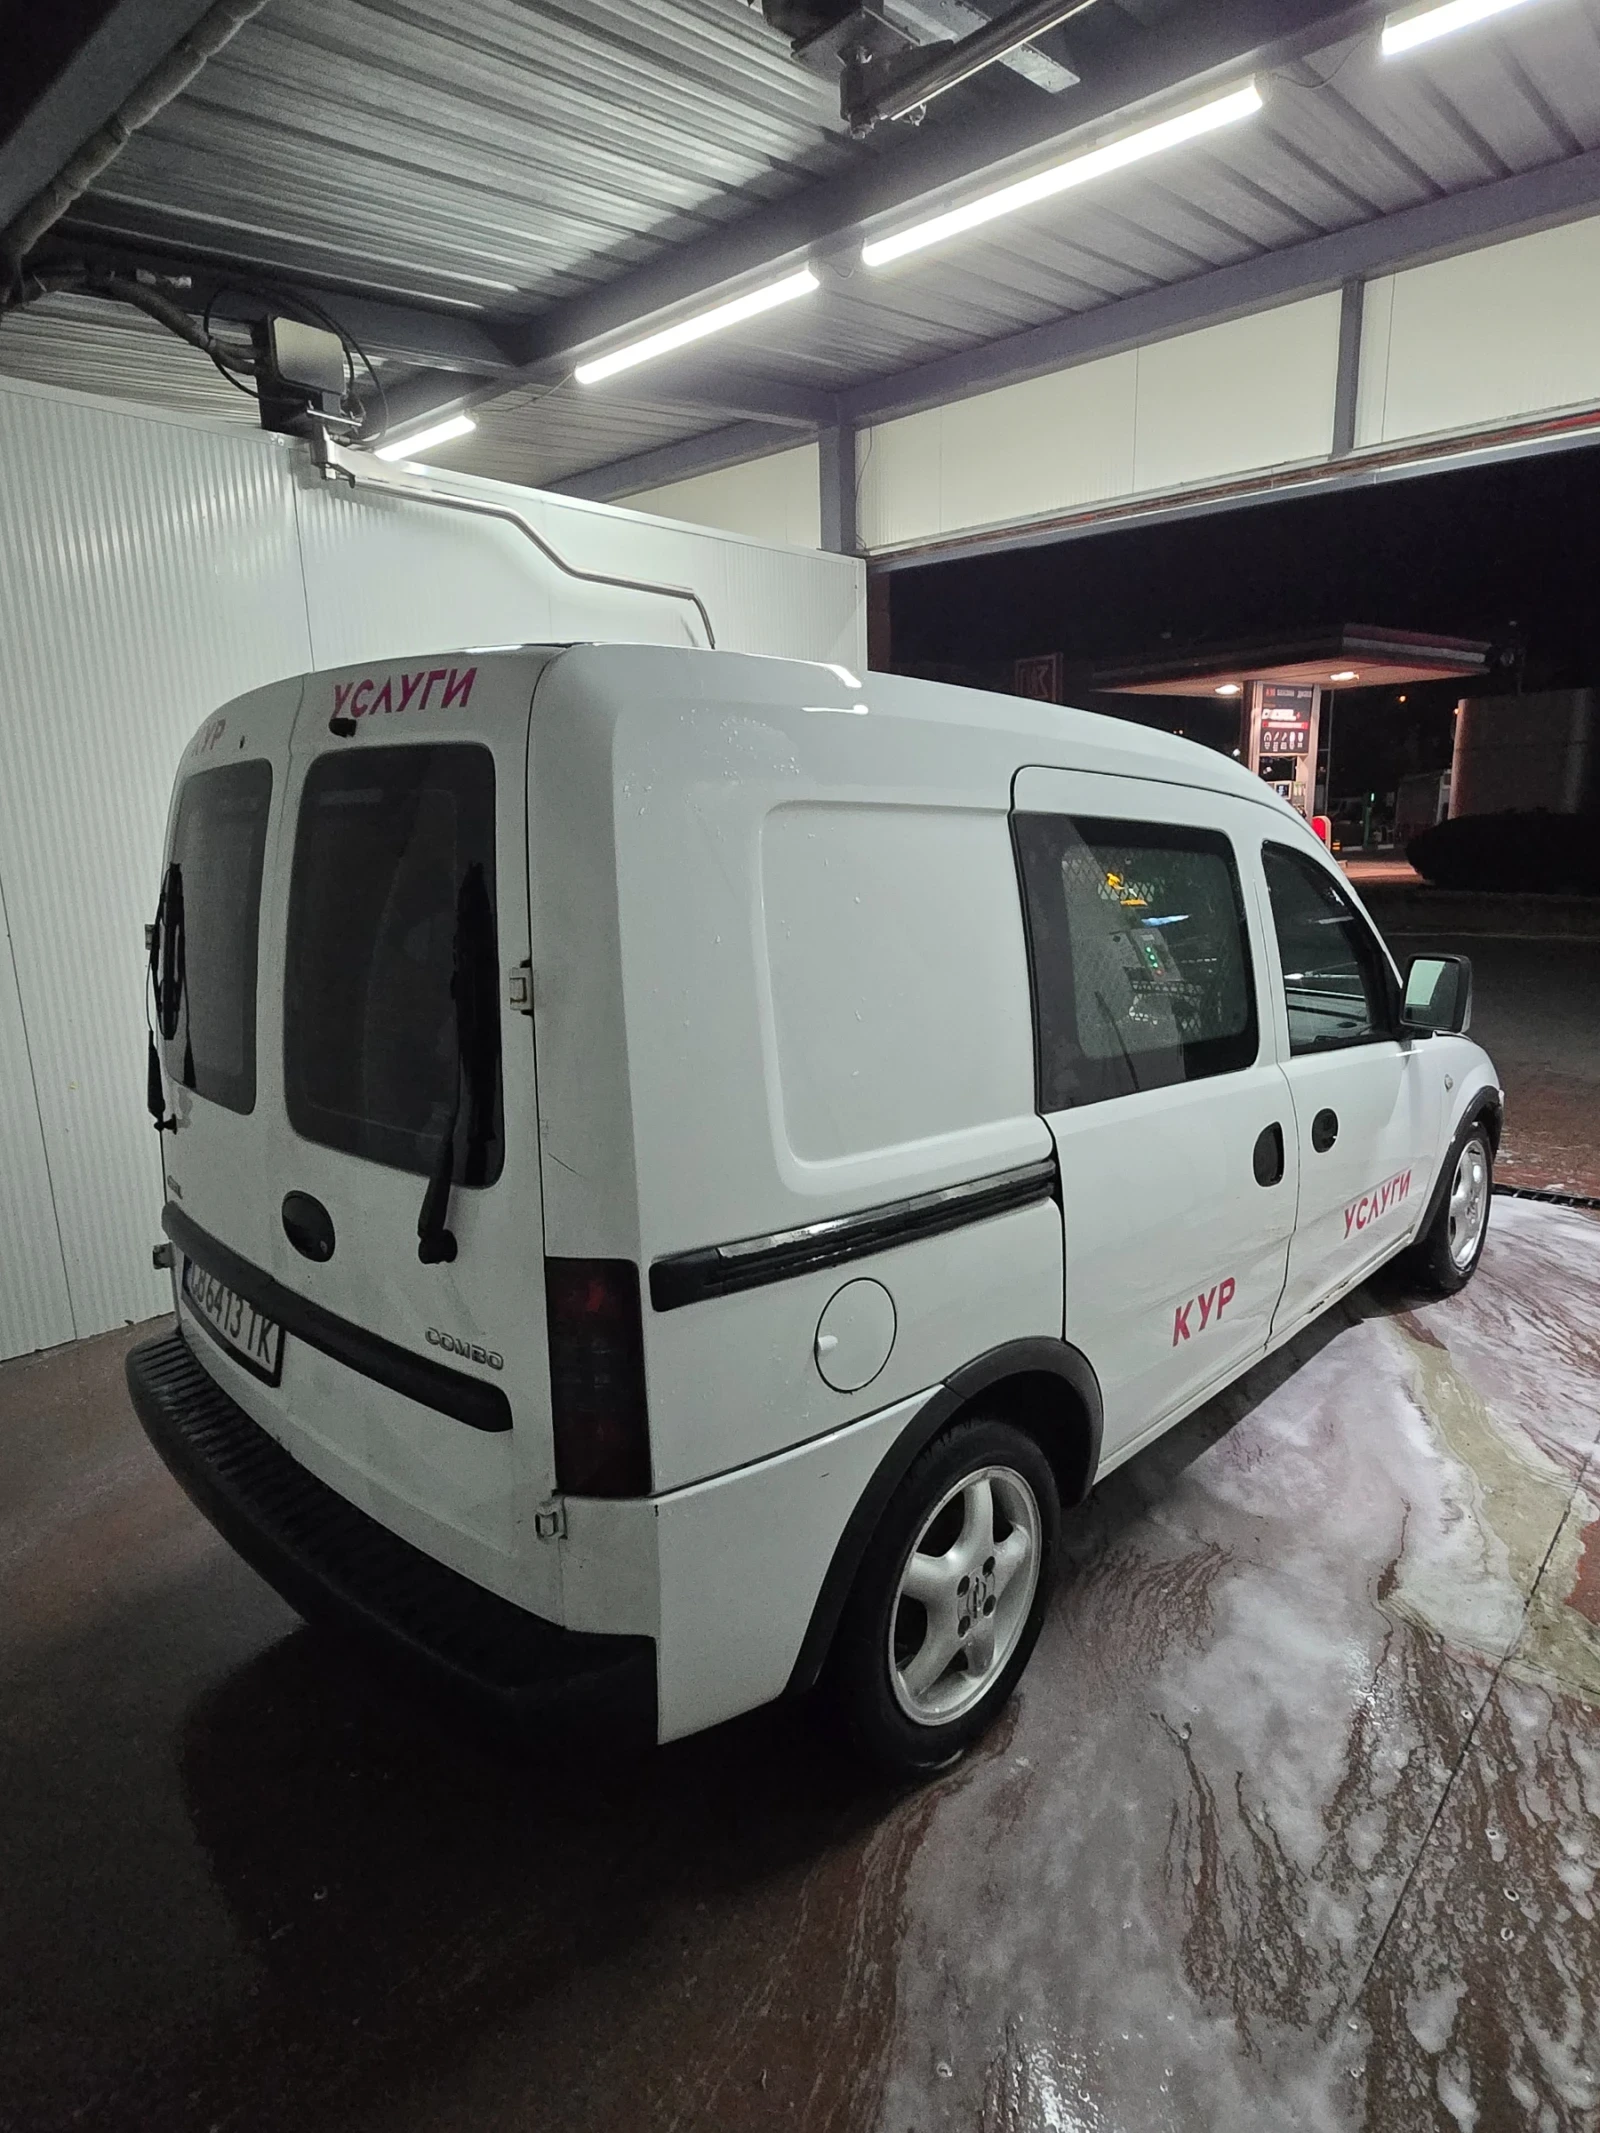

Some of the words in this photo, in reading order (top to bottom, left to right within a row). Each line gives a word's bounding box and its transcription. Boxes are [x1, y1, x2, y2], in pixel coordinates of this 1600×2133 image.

[331, 667, 478, 720] УСЛУГИ
[1343, 1169, 1412, 1240] УСЛУГИ
[1172, 1276, 1236, 1347] КУР
[424, 1326, 505, 1371] COMBO
